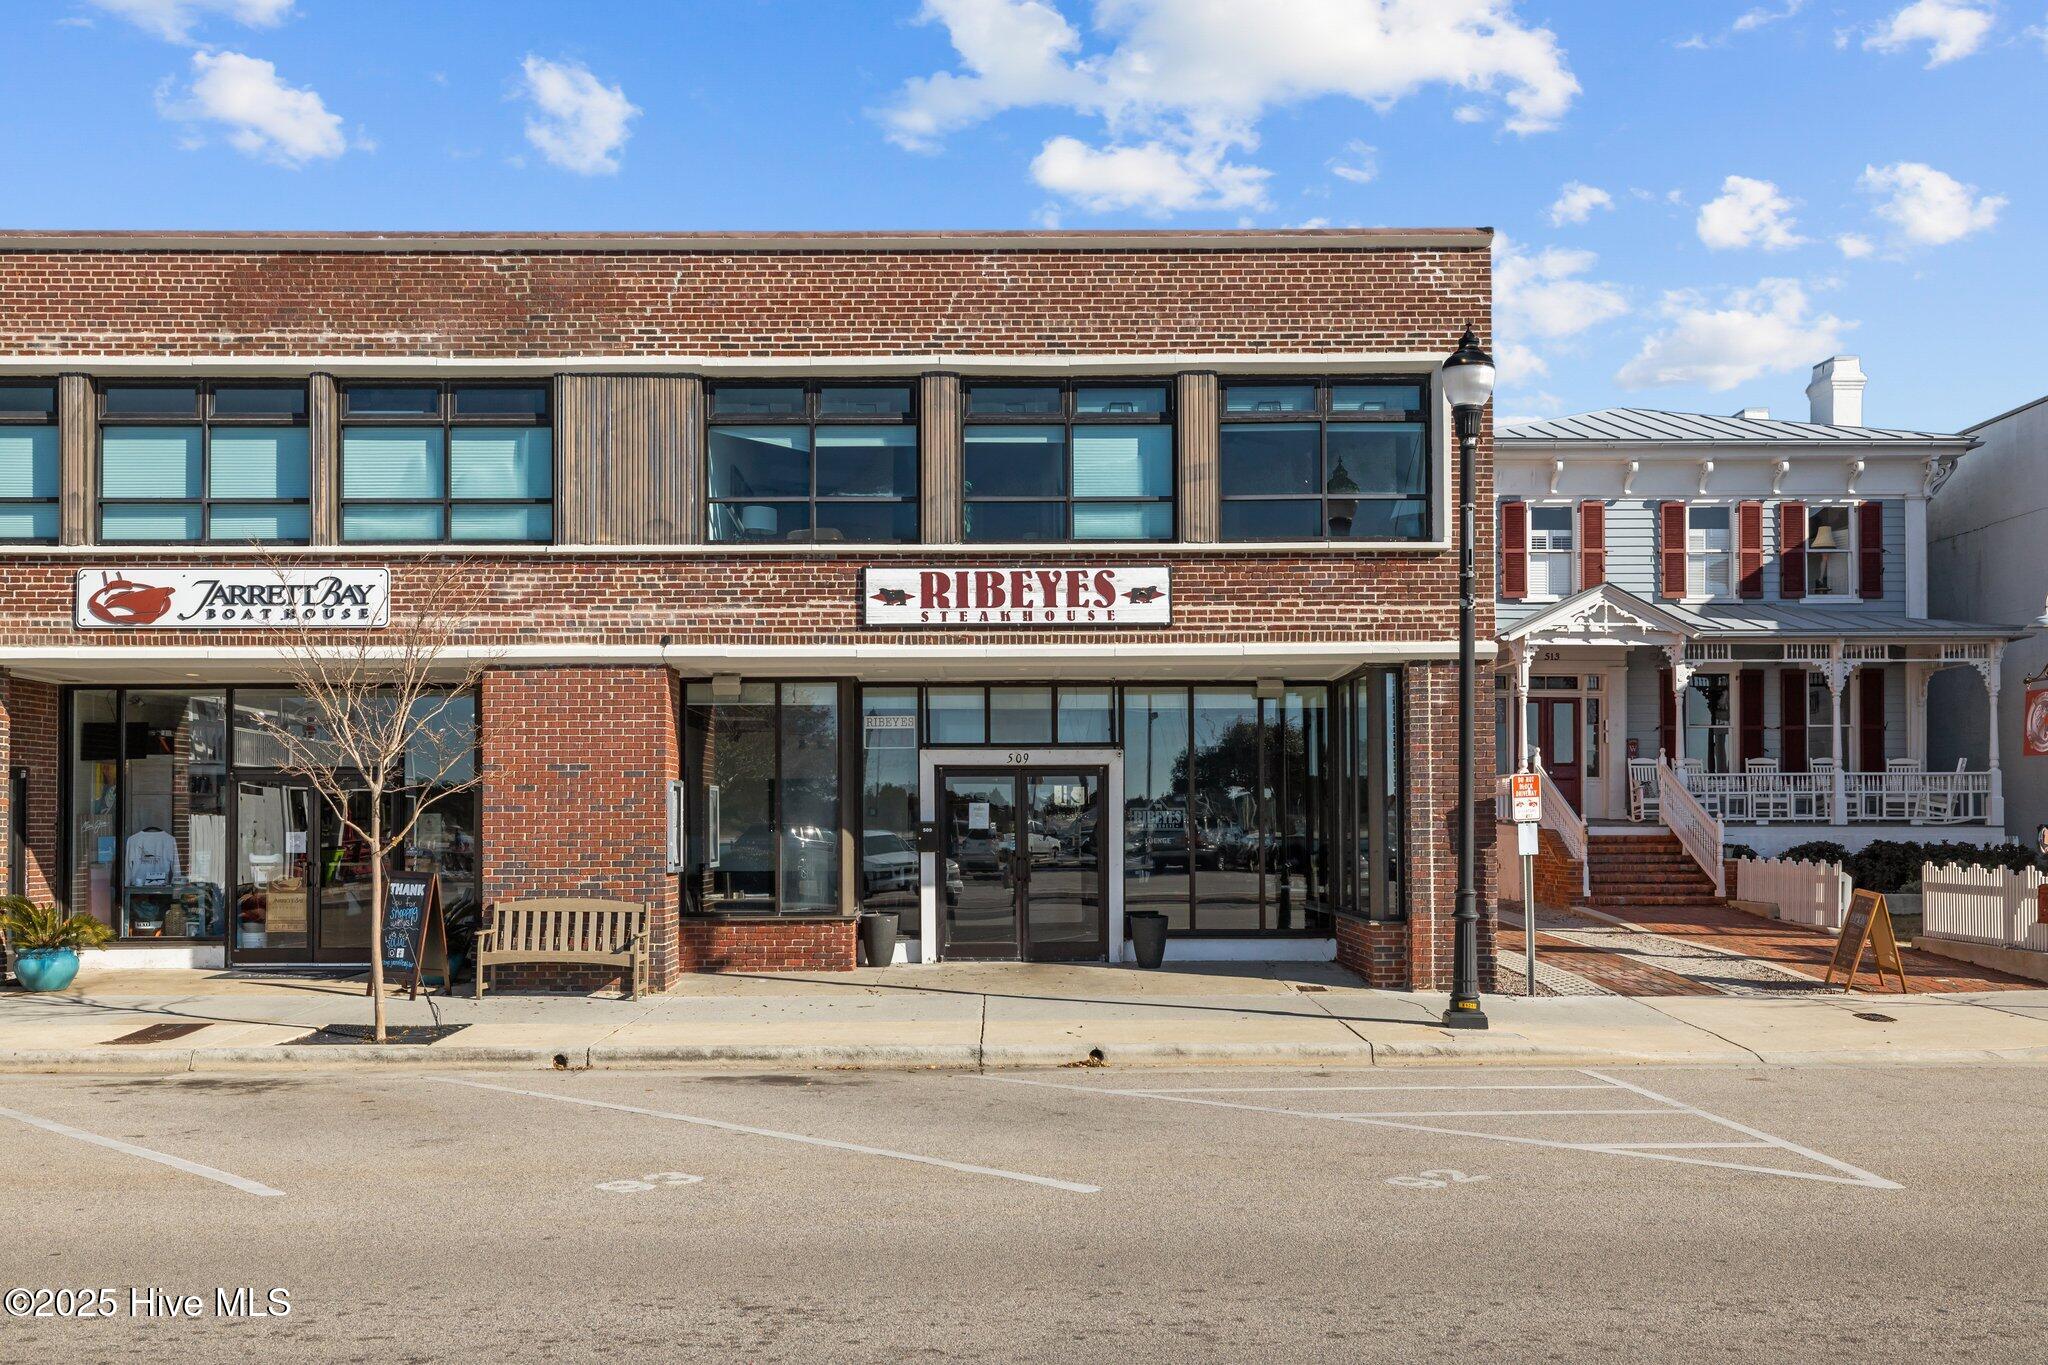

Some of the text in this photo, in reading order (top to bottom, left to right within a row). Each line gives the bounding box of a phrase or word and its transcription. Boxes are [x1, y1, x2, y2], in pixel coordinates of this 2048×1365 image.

[919, 570, 1117, 609] RIBEYES
[920, 610, 1116, 622] STEAKHOUSE
[1544, 652, 1560, 661] 513
[866, 717, 914, 727] RIBEYES
[1006, 752, 1029, 764] 509
[390, 883, 426, 896] THANK
